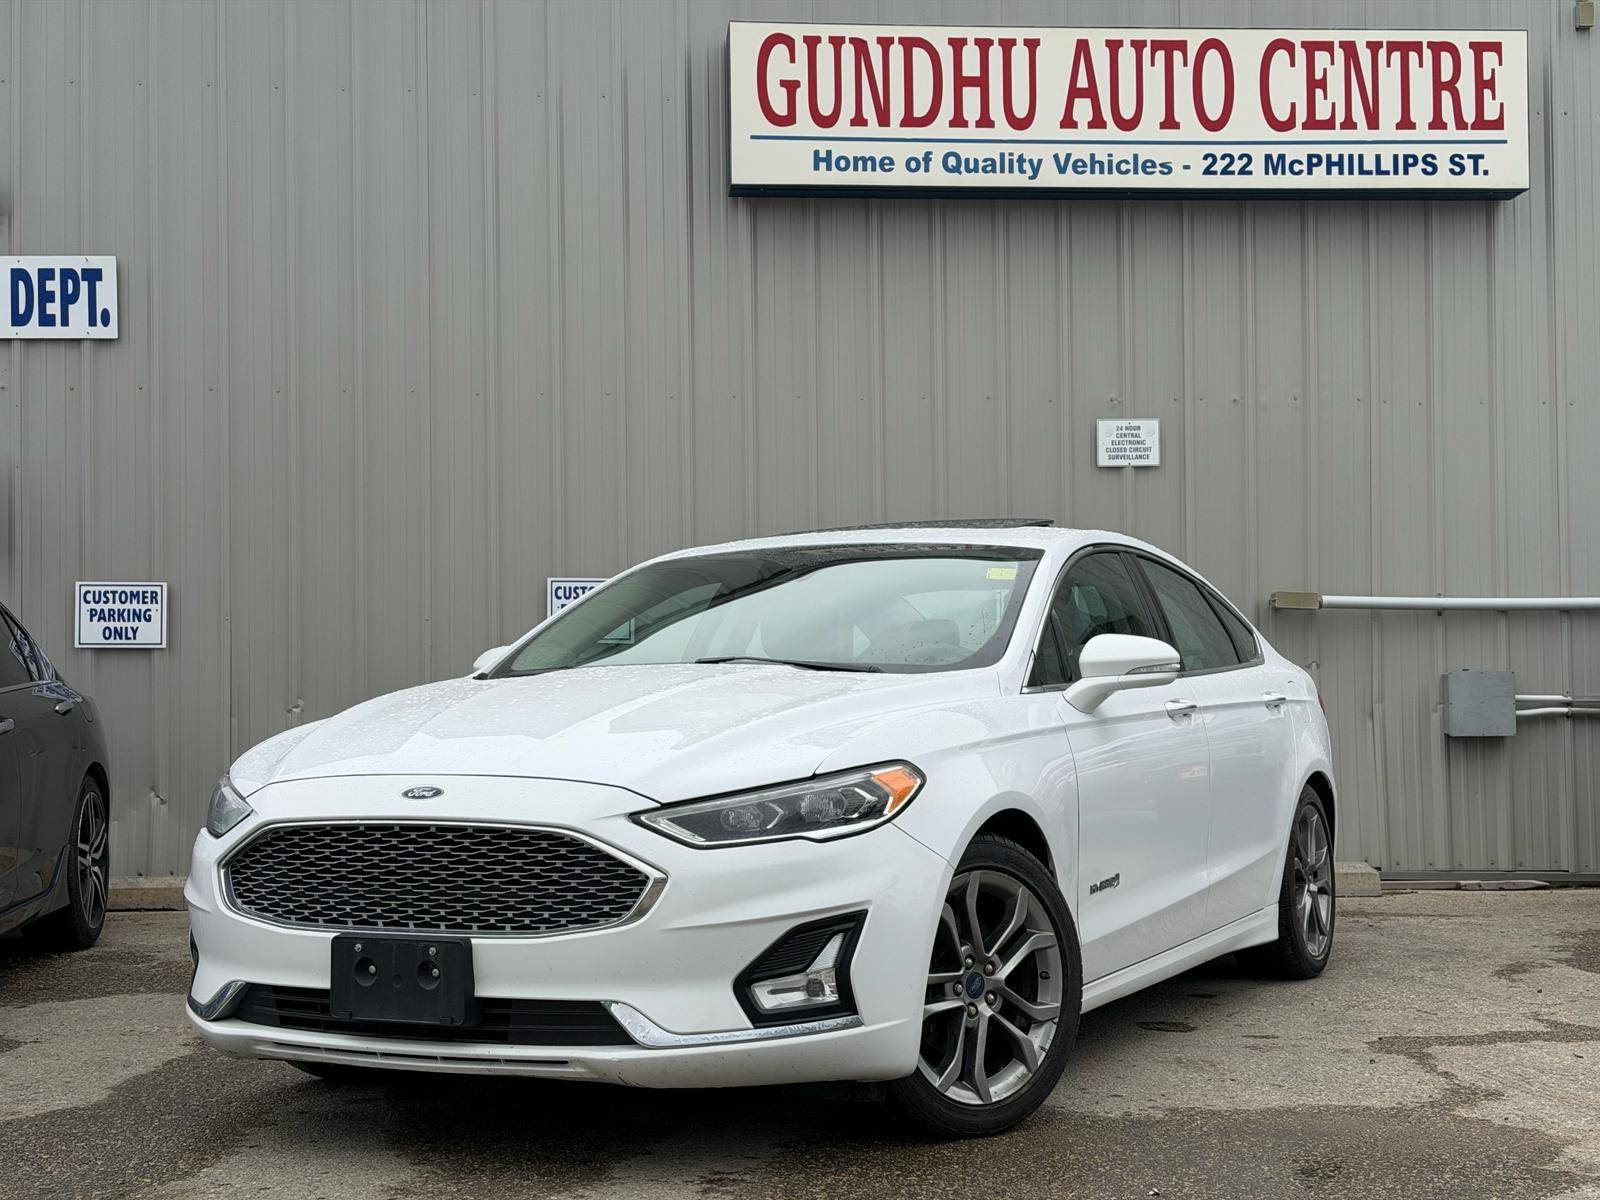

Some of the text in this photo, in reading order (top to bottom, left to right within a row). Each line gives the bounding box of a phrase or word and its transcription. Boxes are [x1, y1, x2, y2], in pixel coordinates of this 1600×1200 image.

[756, 32, 1505, 132] GUNDHU AUTO CENTRE
[812, 149, 895, 173] Home
[905, 151, 933, 173] of
[942, 151, 1044, 180] Quality
[1053, 152, 1174, 176] Vehicles
[1202, 152, 1254, 177] 222
[1264, 153, 1439, 176] McPHILLIPS
[1448, 153, 1489, 176] ST.
[10, 268, 111, 328] DEPT.
[83, 590, 159, 605] CUSTOMER
[89, 608, 152, 623] PARKING
[102, 626, 139, 641] ONLY
